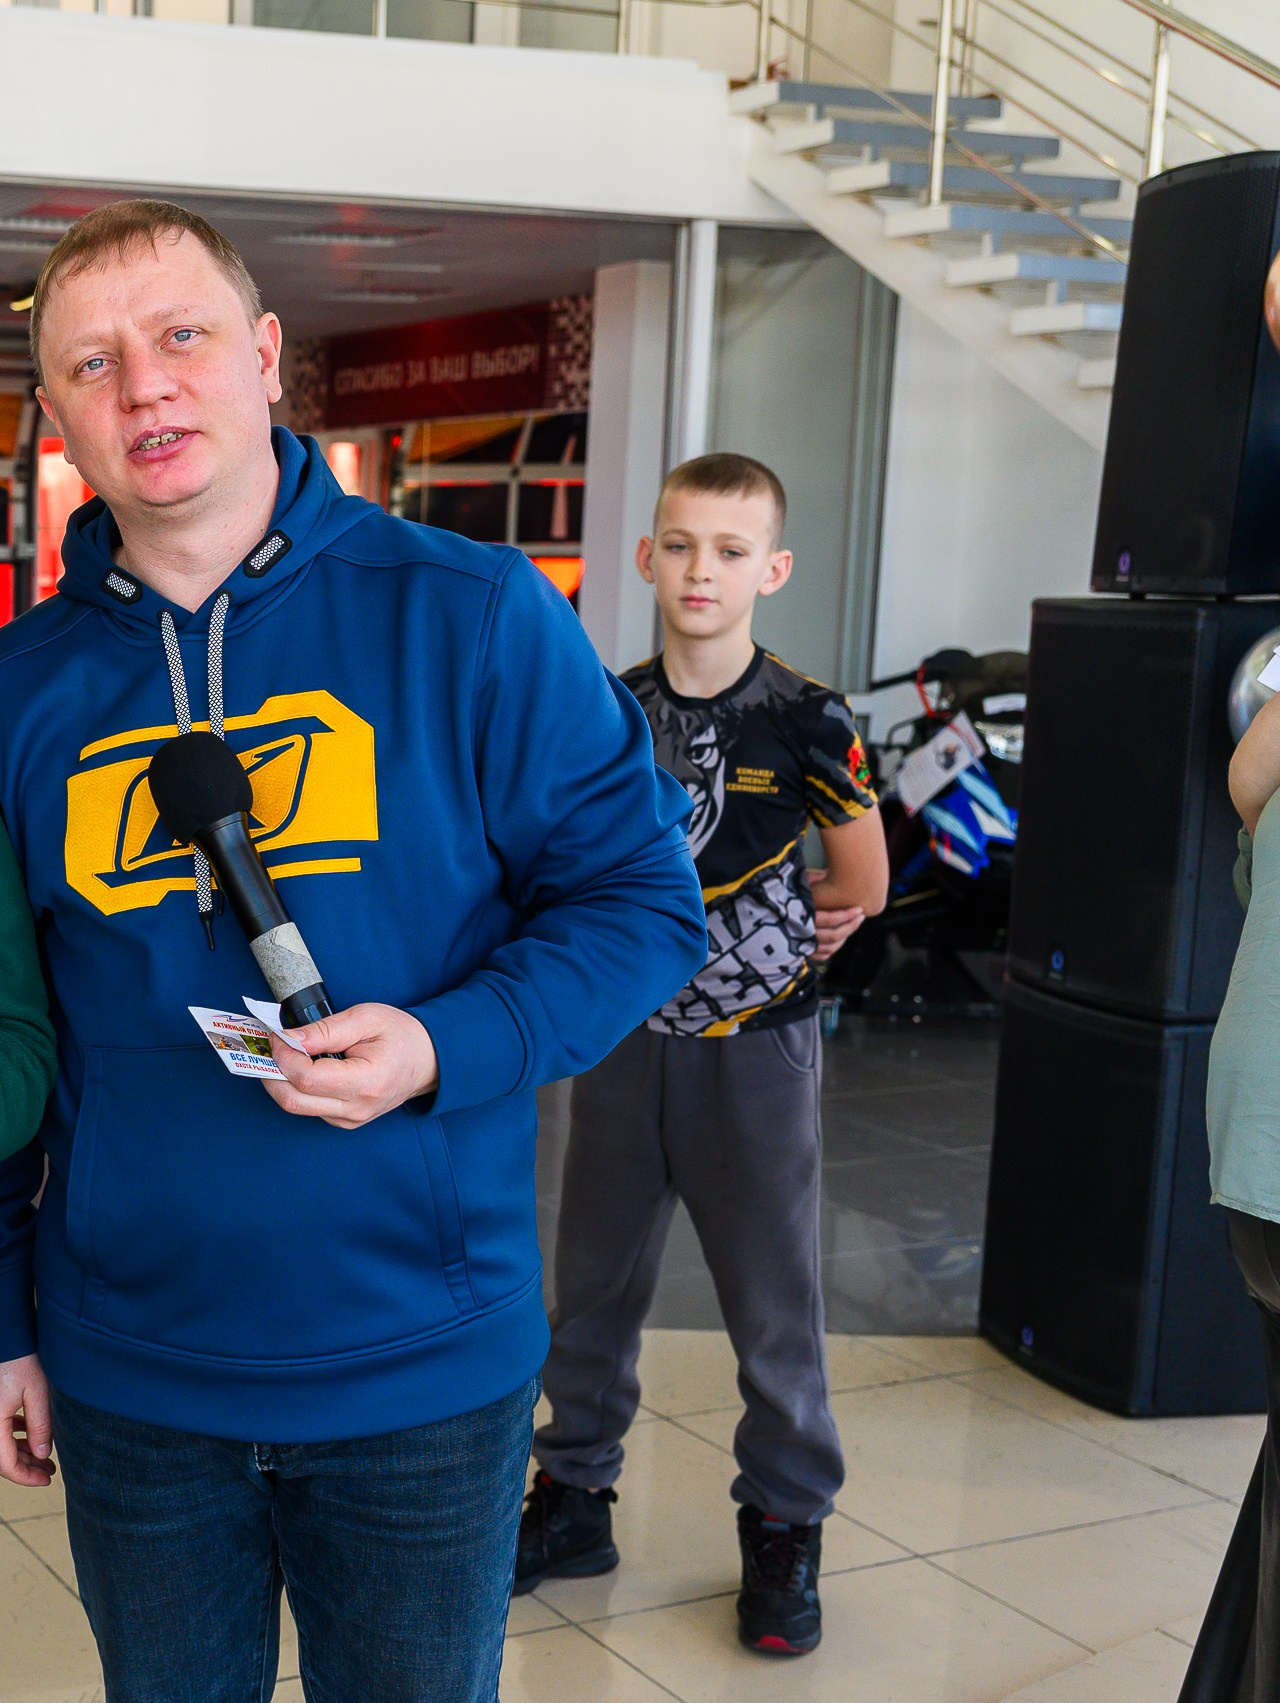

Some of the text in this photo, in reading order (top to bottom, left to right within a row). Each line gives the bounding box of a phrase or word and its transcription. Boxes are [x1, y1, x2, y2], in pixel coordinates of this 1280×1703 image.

[334, 343, 540, 396] СПАСИБО ЗА ВАШ ВЫБОР!
[212, 1021, 247, 1033] АКТИВНЫЙ
[229, 1052, 278, 1068] ВСЕ ЛУЧШЕ
[234, 1062, 253, 1070] ОХОТА
